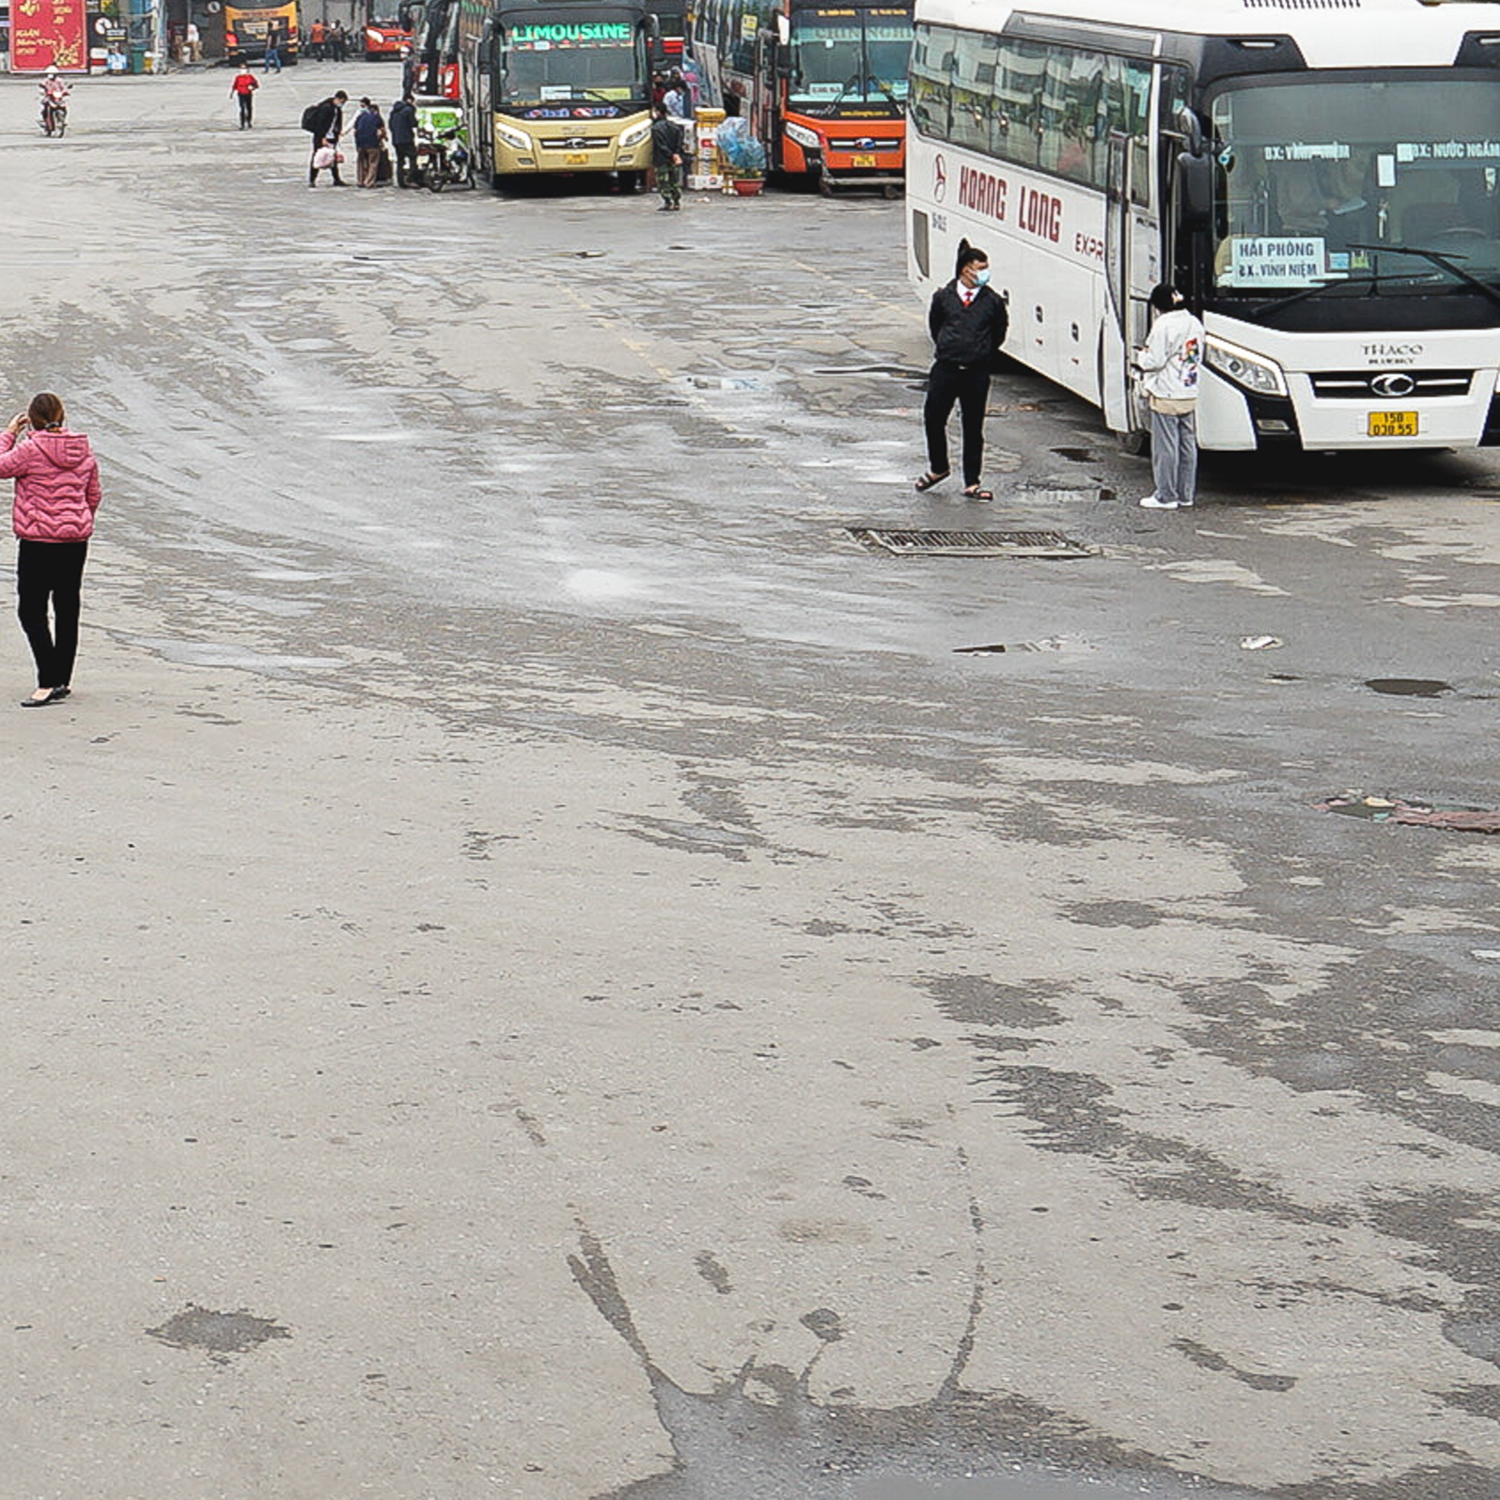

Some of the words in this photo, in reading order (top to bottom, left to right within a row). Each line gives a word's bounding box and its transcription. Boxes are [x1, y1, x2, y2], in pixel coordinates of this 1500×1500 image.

[511, 23, 631, 42] LIMOUSINE
[1433, 139, 1464, 158] NƯỚC
[1018, 186, 1064, 243] LONG
[1267, 240, 1314, 257] PHÒNG
[1362, 344, 1423, 355] THACO
